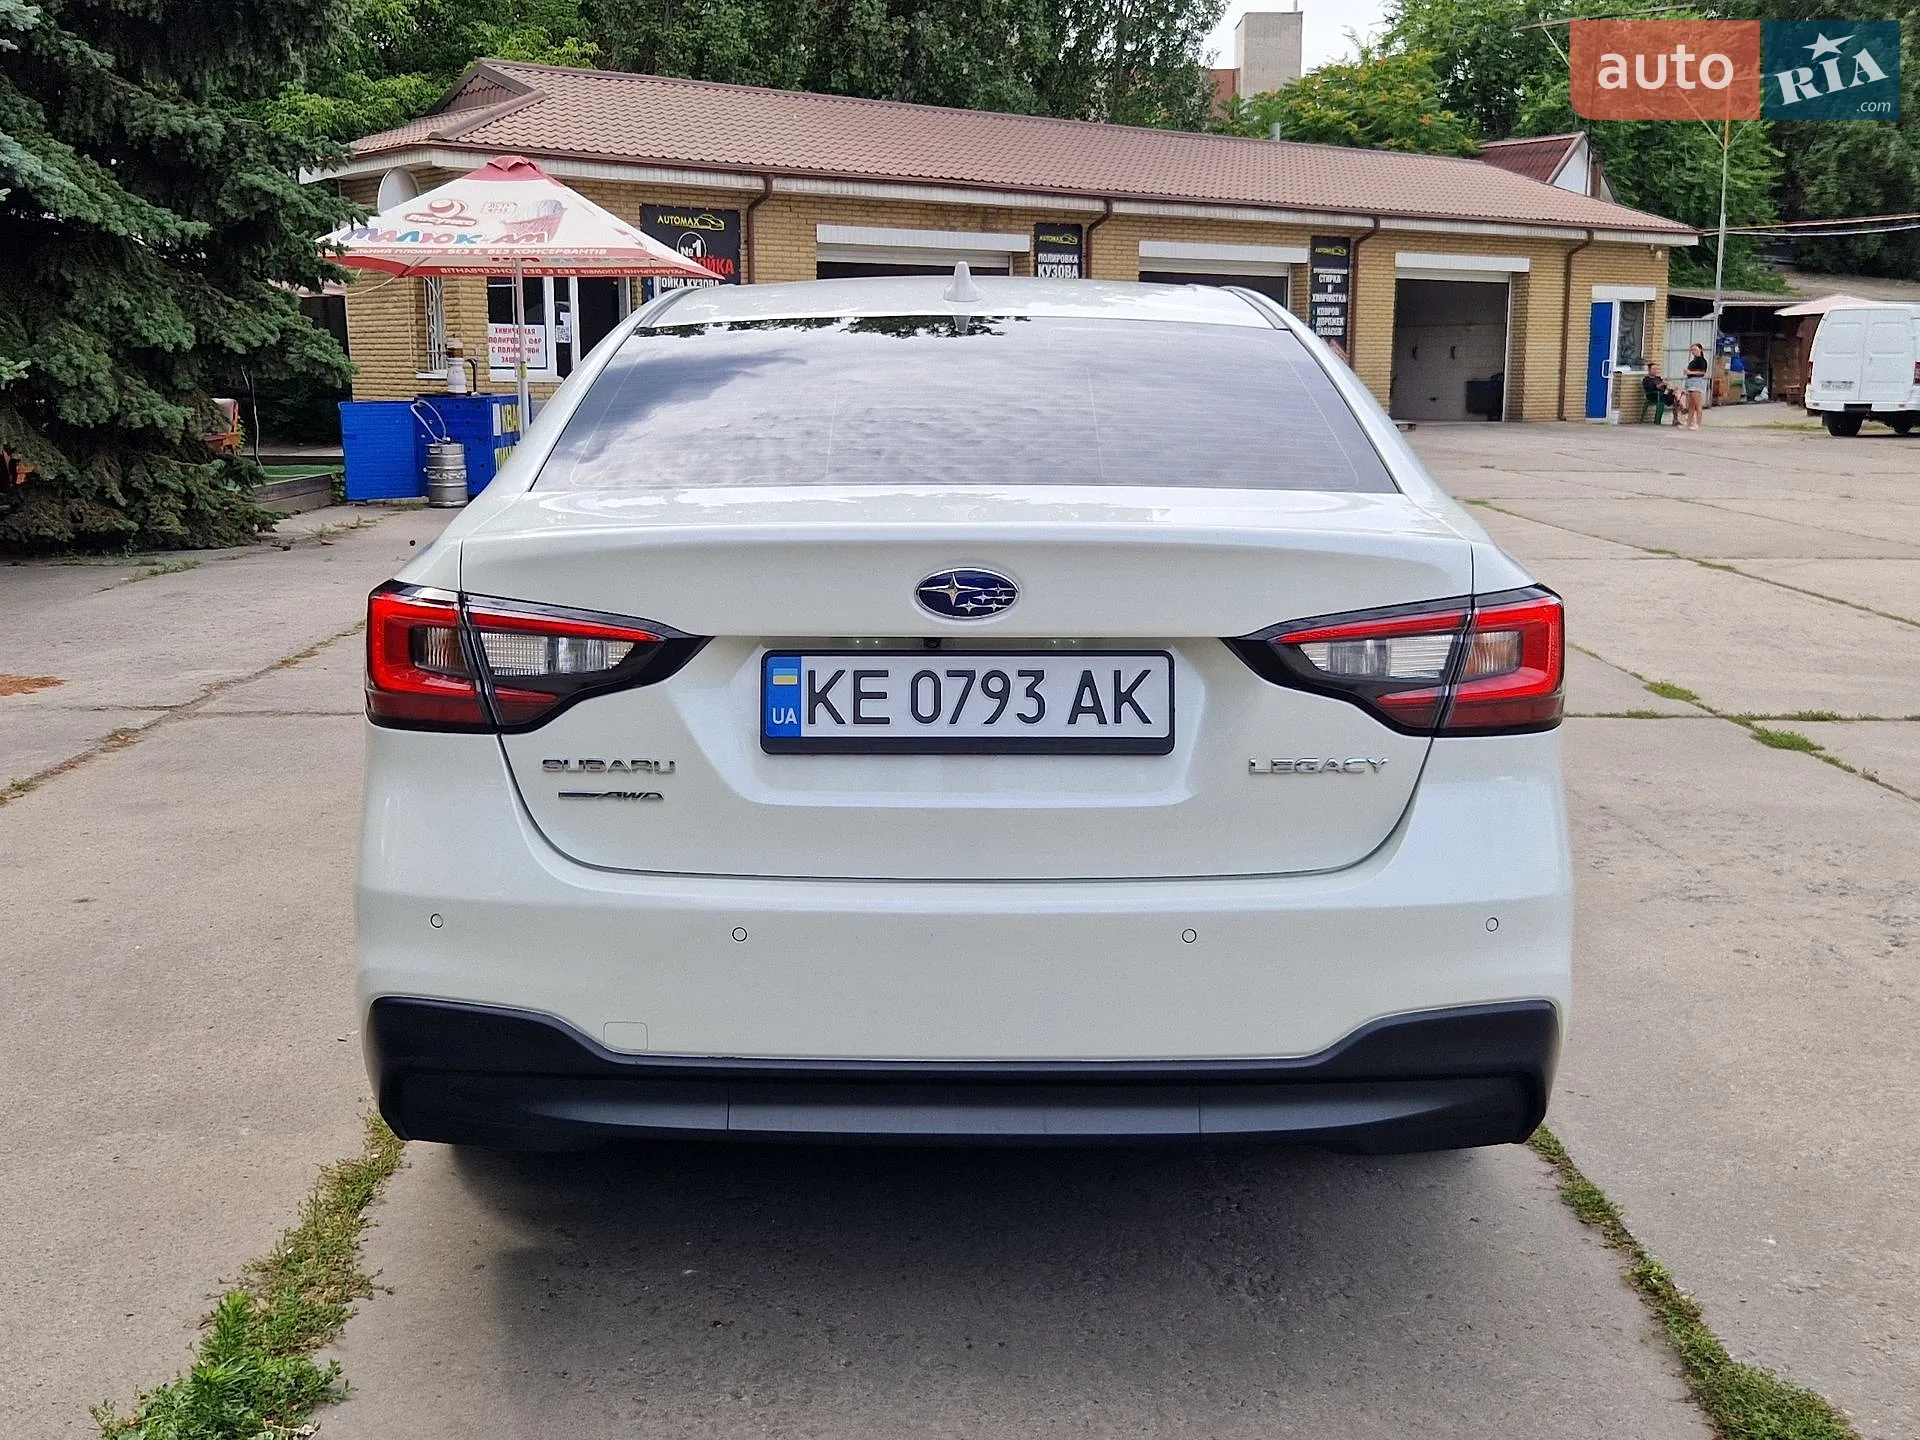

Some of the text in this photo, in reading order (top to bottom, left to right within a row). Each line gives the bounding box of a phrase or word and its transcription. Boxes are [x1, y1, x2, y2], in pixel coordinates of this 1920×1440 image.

[657, 214, 700, 227] AUTOMAX
[1038, 253, 1079, 264] ПОЛИРОВКА
[1037, 263, 1079, 279] КУЗОВА
[807, 669, 1152, 725] KE 0793 AK
[772, 707, 798, 725] UA
[542, 759, 676, 774] SUBARU
[1248, 757, 1389, 774] LEGACY
